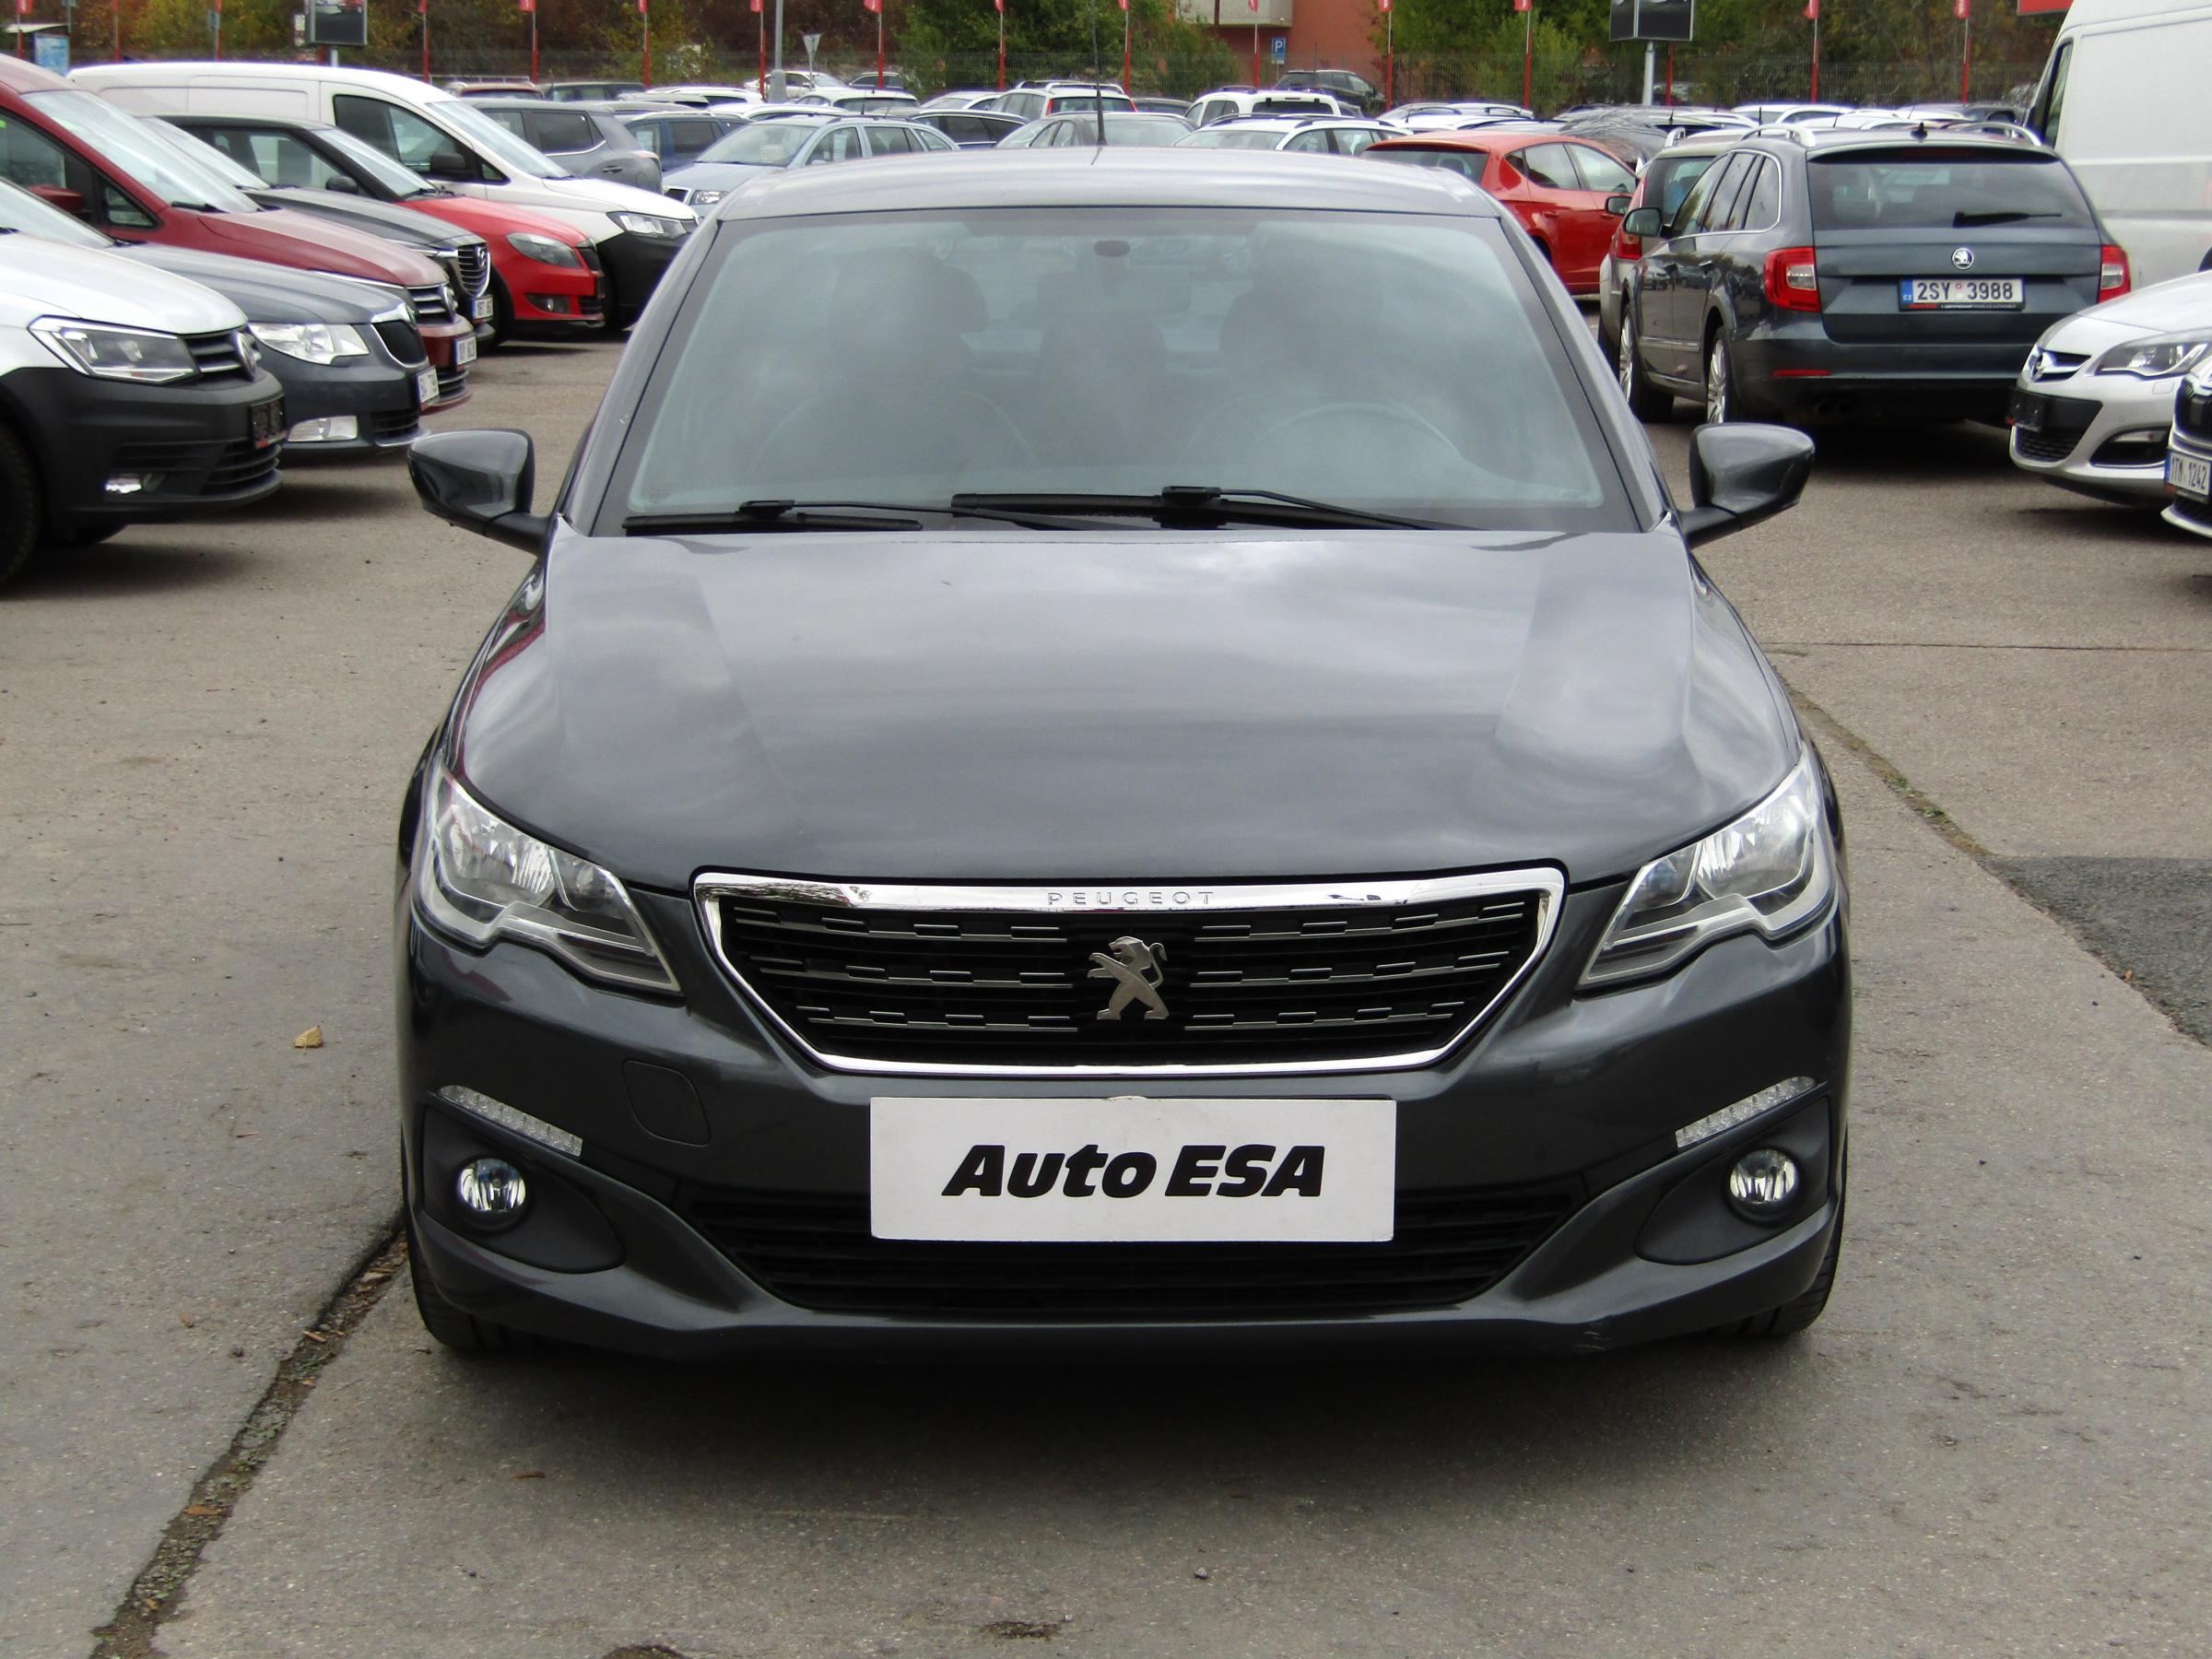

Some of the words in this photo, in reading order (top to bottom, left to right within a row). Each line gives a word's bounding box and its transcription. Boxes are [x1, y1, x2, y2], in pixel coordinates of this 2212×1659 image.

[1275, 41, 1283, 53] P
[1917, 282, 1950, 300] 2SY
[1967, 282, 2013, 300] 3988
[1047, 891, 1214, 905] PEUGEOT
[941, 1144, 1158, 1199] Auto
[1164, 1144, 1325, 1198] ESA
